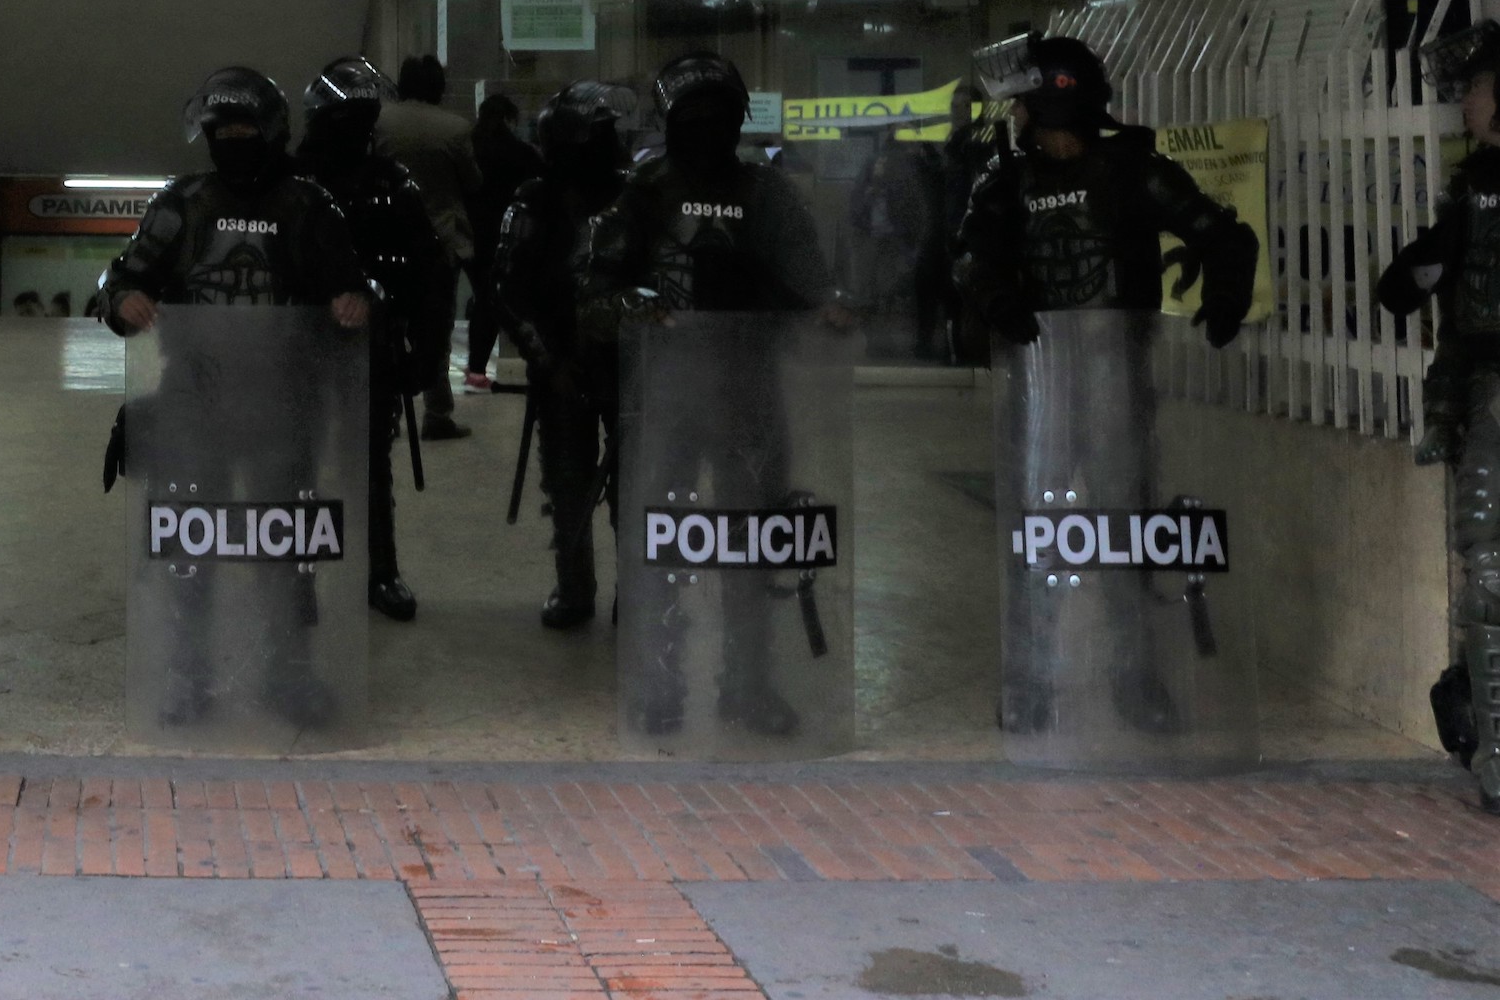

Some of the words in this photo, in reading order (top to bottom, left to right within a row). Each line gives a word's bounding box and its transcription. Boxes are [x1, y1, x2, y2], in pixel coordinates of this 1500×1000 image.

[1166, 126, 1224, 153] EMAIL
[681, 201, 744, 220] 039148
[1028, 190, 1088, 213] 039347
[1479, 193, 1500, 209] 06
[216, 217, 279, 236] 038804
[150, 506, 341, 557] POLICIA
[646, 511, 835, 565] POLICIA
[1024, 513, 1227, 566] POLICIA
